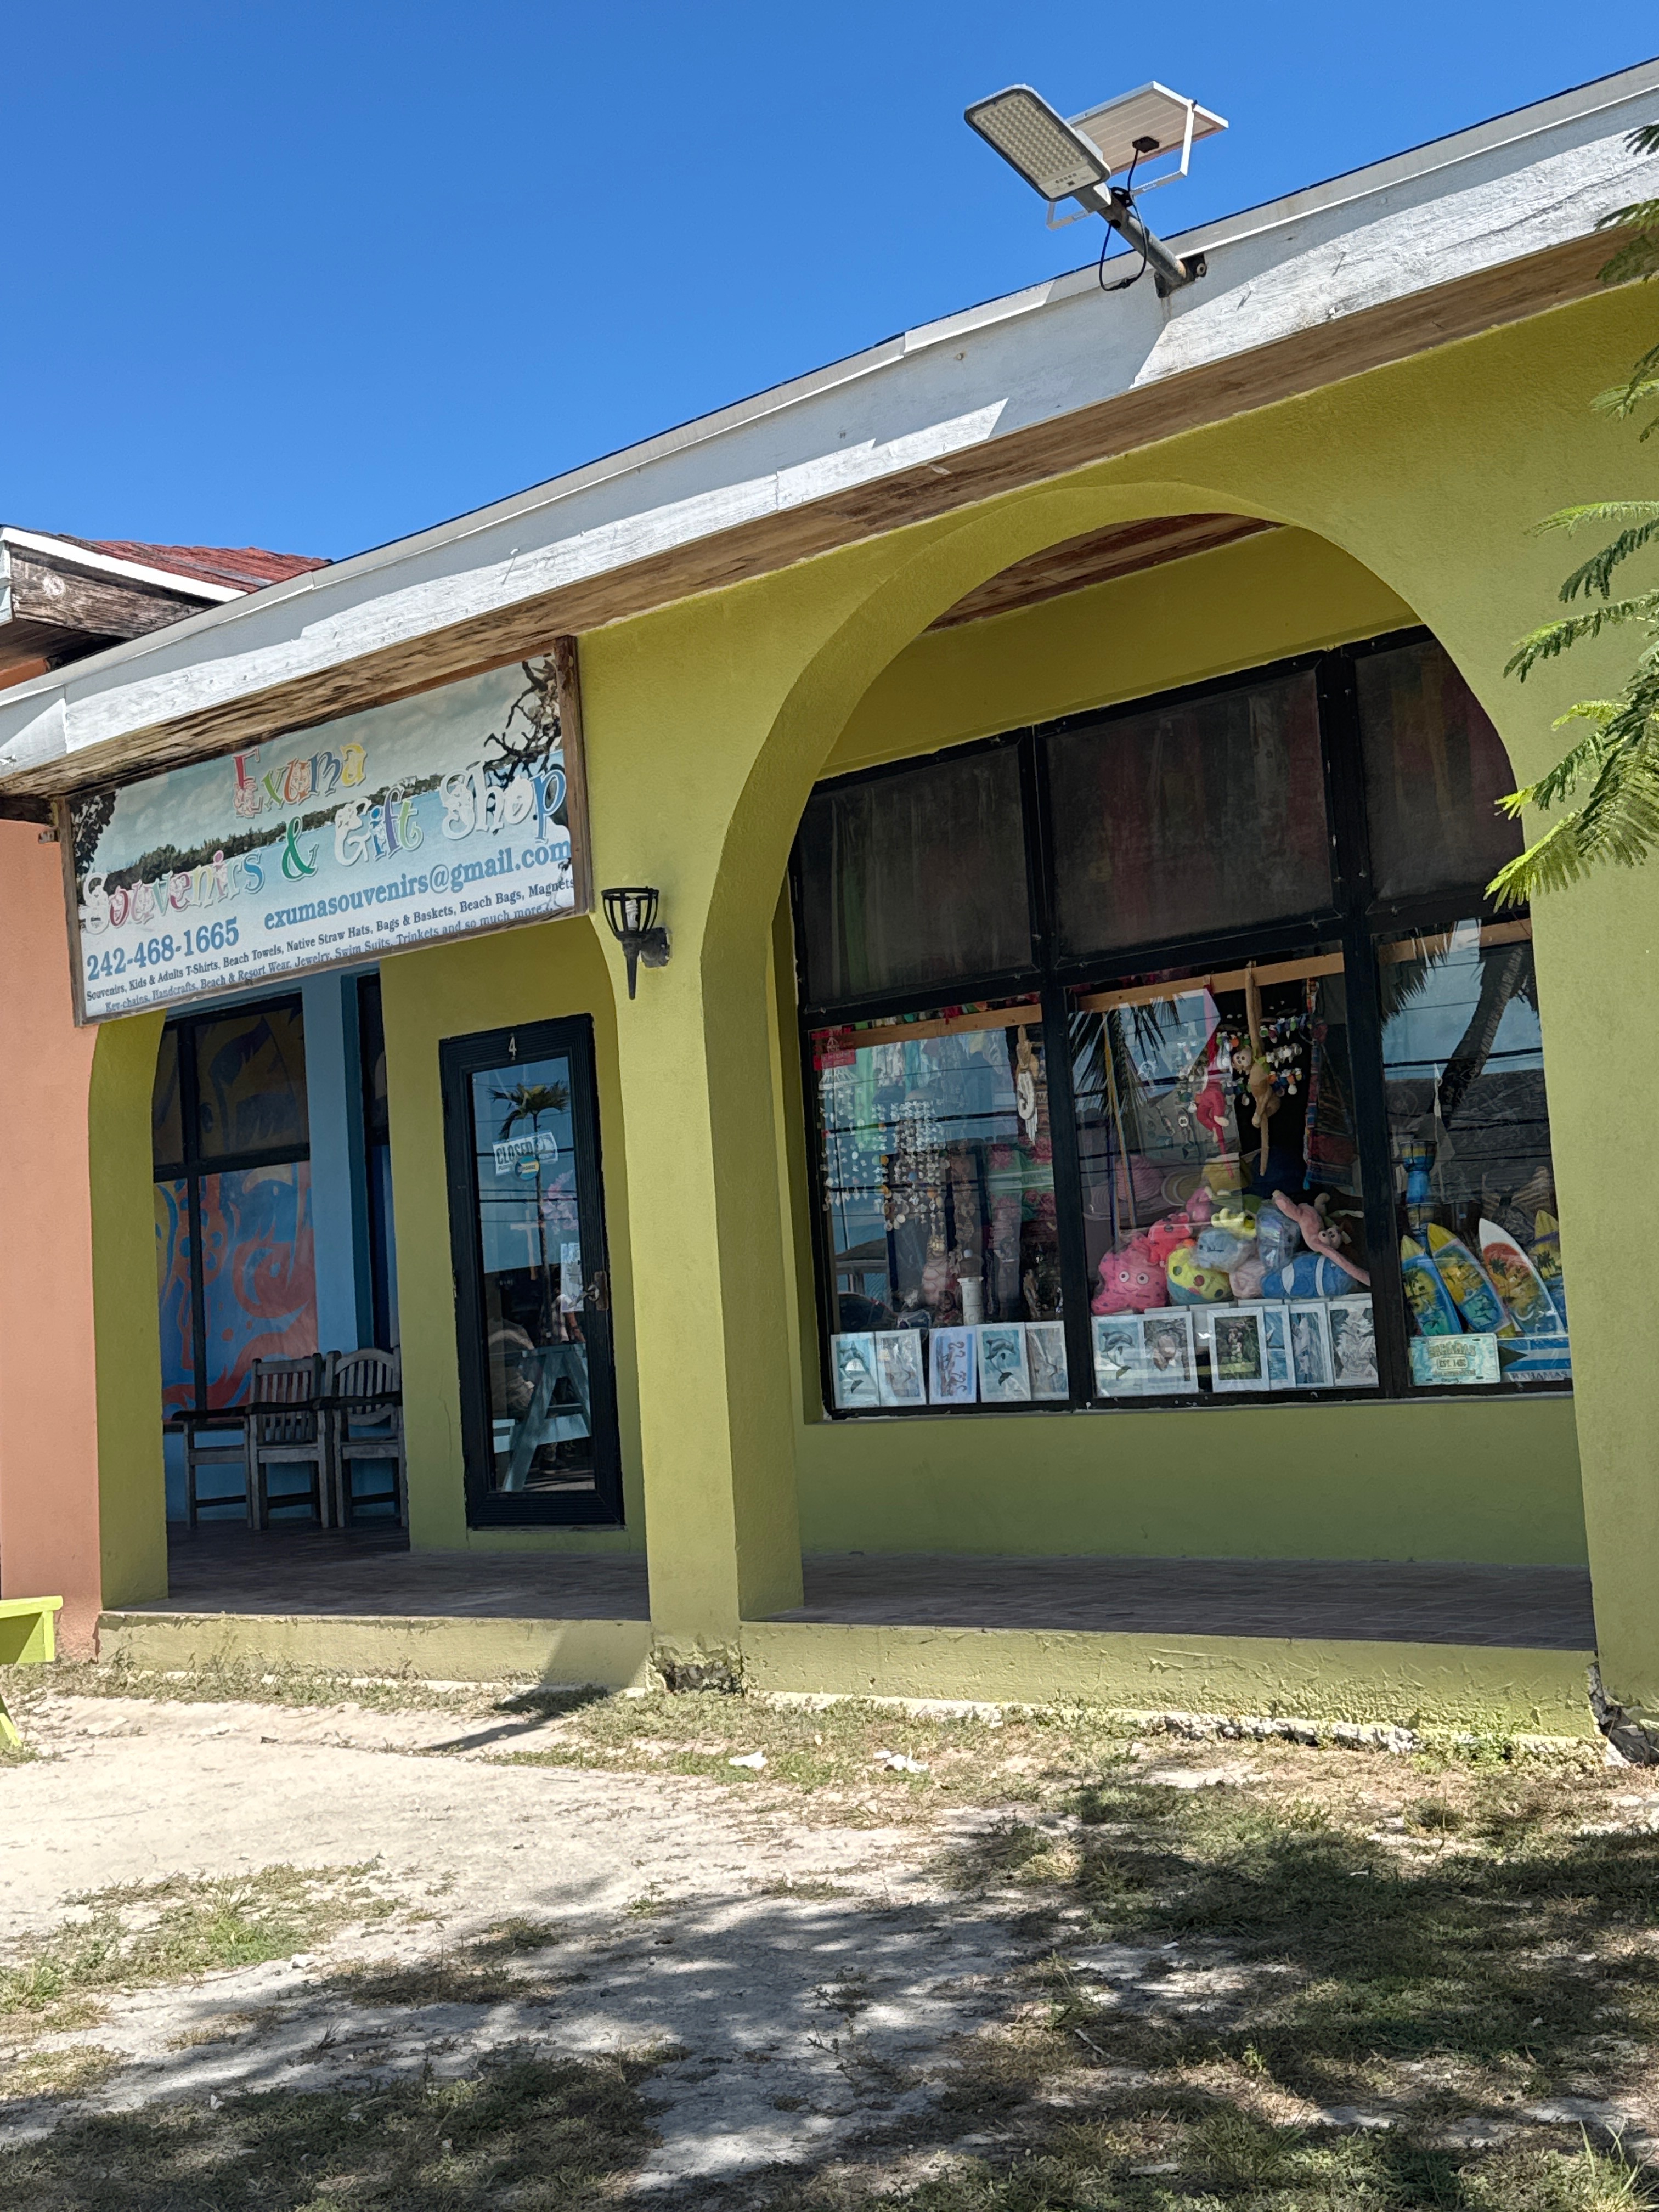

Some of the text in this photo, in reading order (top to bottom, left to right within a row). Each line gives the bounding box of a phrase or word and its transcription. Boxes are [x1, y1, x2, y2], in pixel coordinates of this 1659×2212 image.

[233, 743, 368, 818] Exuma
[83, 760, 567, 933] Souvenirs & Gift Shop
[87, 840, 571, 981] 242-468-1665 exumasouvenirs@gmail.com
[87, 984, 127, 1001] Souvenirs,
[129, 977, 147, 991] Kids
[149, 974, 156, 985] &
[157, 968, 184, 983] Adults
[186, 961, 220, 976] T-Shirts,
[223, 952, 249, 968] Beach
[252, 945, 284, 960] Towels,
[286, 938, 315, 952] Native
[318, 931, 345, 945] Straw
[348, 925, 373, 938] Hats,
[376, 919, 400, 932] Bags
[403, 914, 411, 926] &
[413, 906, 457, 923] Baskets,
[460, 895, 492, 913] Beach
[495, 890, 524, 905] Bags,
[153, 982, 199, 1000] Handcrafts,
[200, 975, 226, 990] Beach
[229, 971, 235, 983] &
[238, 967, 266, 980] Resort
[335, 944, 362, 959] Swim
[396, 927, 439, 945] Trinkets
[442, 920, 461, 934] and
[465, 920, 477, 930] so
[480, 910, 510, 926] much
[509, 1037, 517, 1056] 4
[495, 1141, 533, 1164] CLOSED
